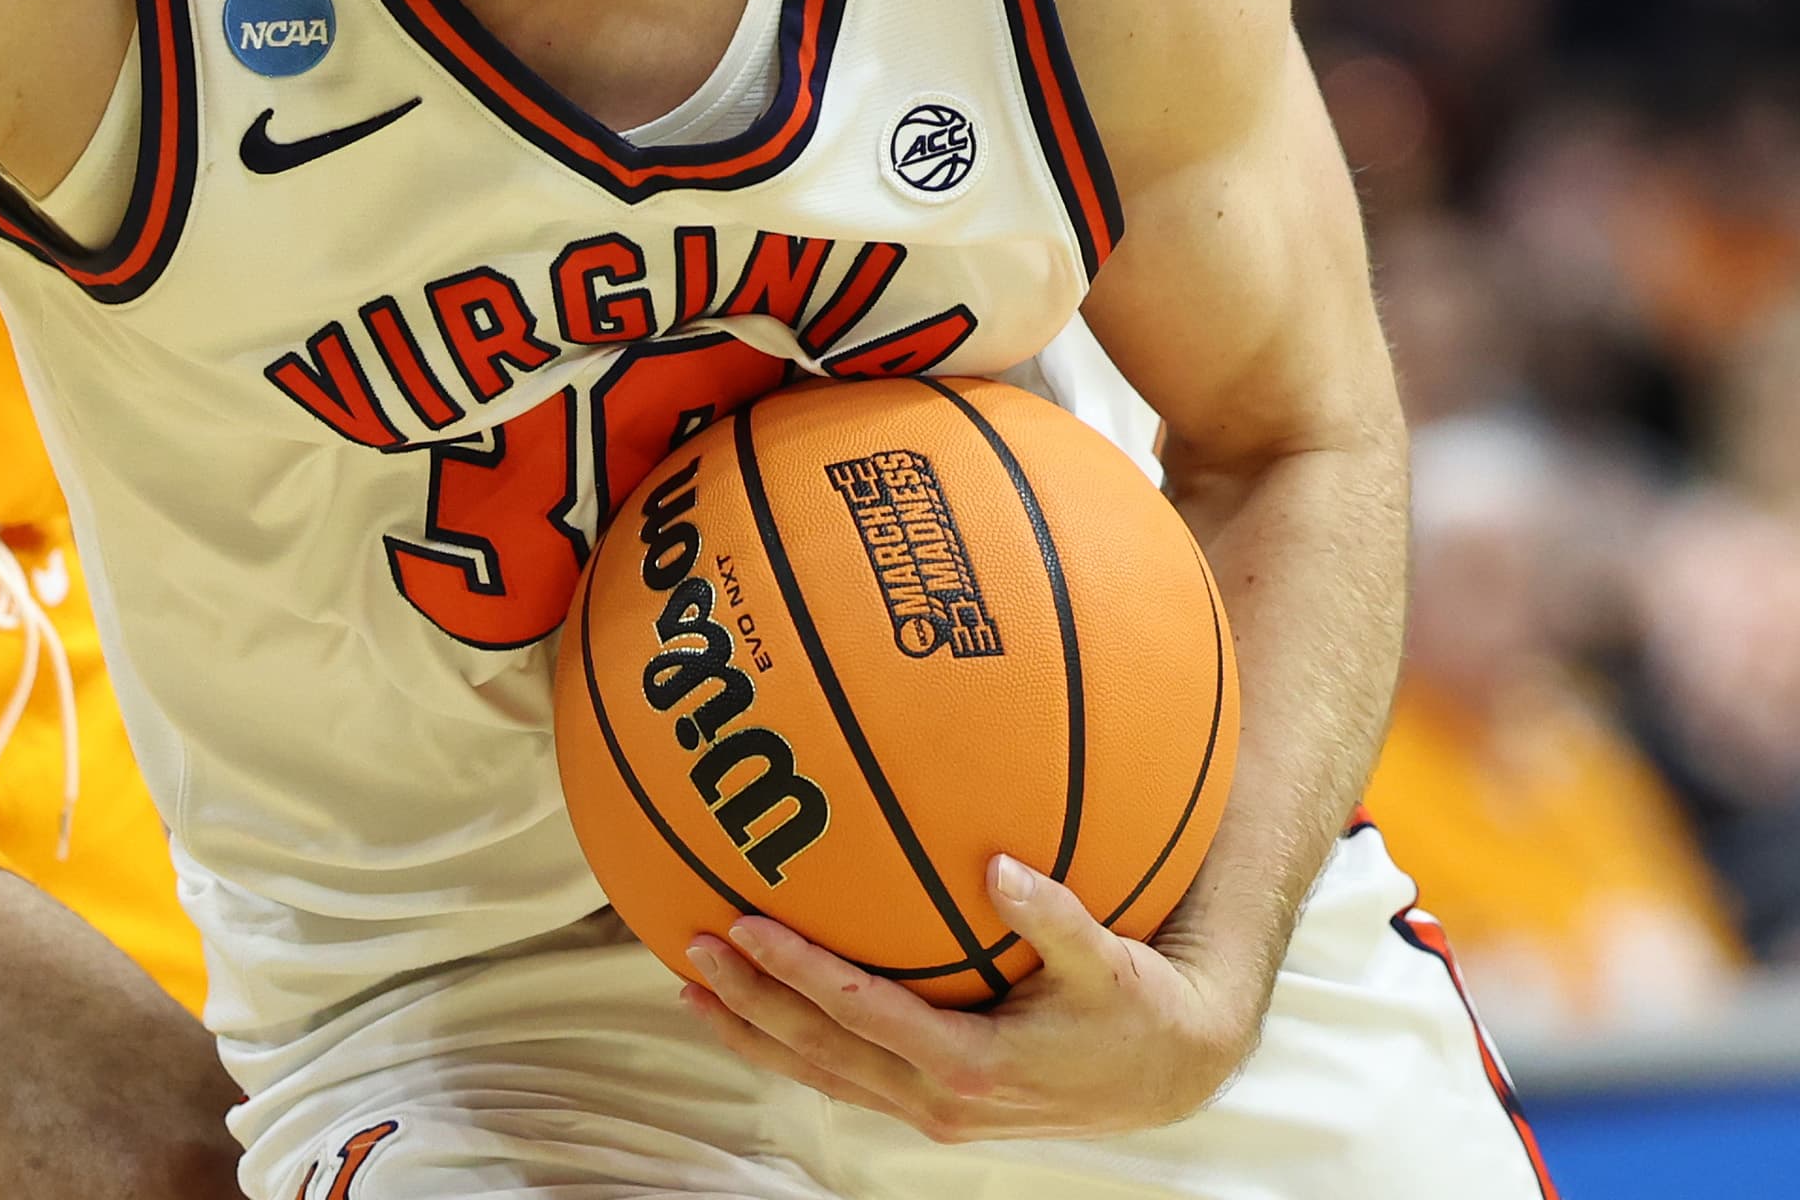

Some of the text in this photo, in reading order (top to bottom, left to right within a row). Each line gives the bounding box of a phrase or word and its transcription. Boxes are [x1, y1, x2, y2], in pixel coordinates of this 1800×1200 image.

[240, 19, 329, 50] NCAA
[901, 121, 969, 162] ACC
[264, 226, 978, 452] VIRGINIA
[856, 504, 932, 617] MARCH
[874, 451, 964, 592] MADNESS
[638, 455, 831, 889] Wilson
[715, 554, 774, 673] EVO NXT
